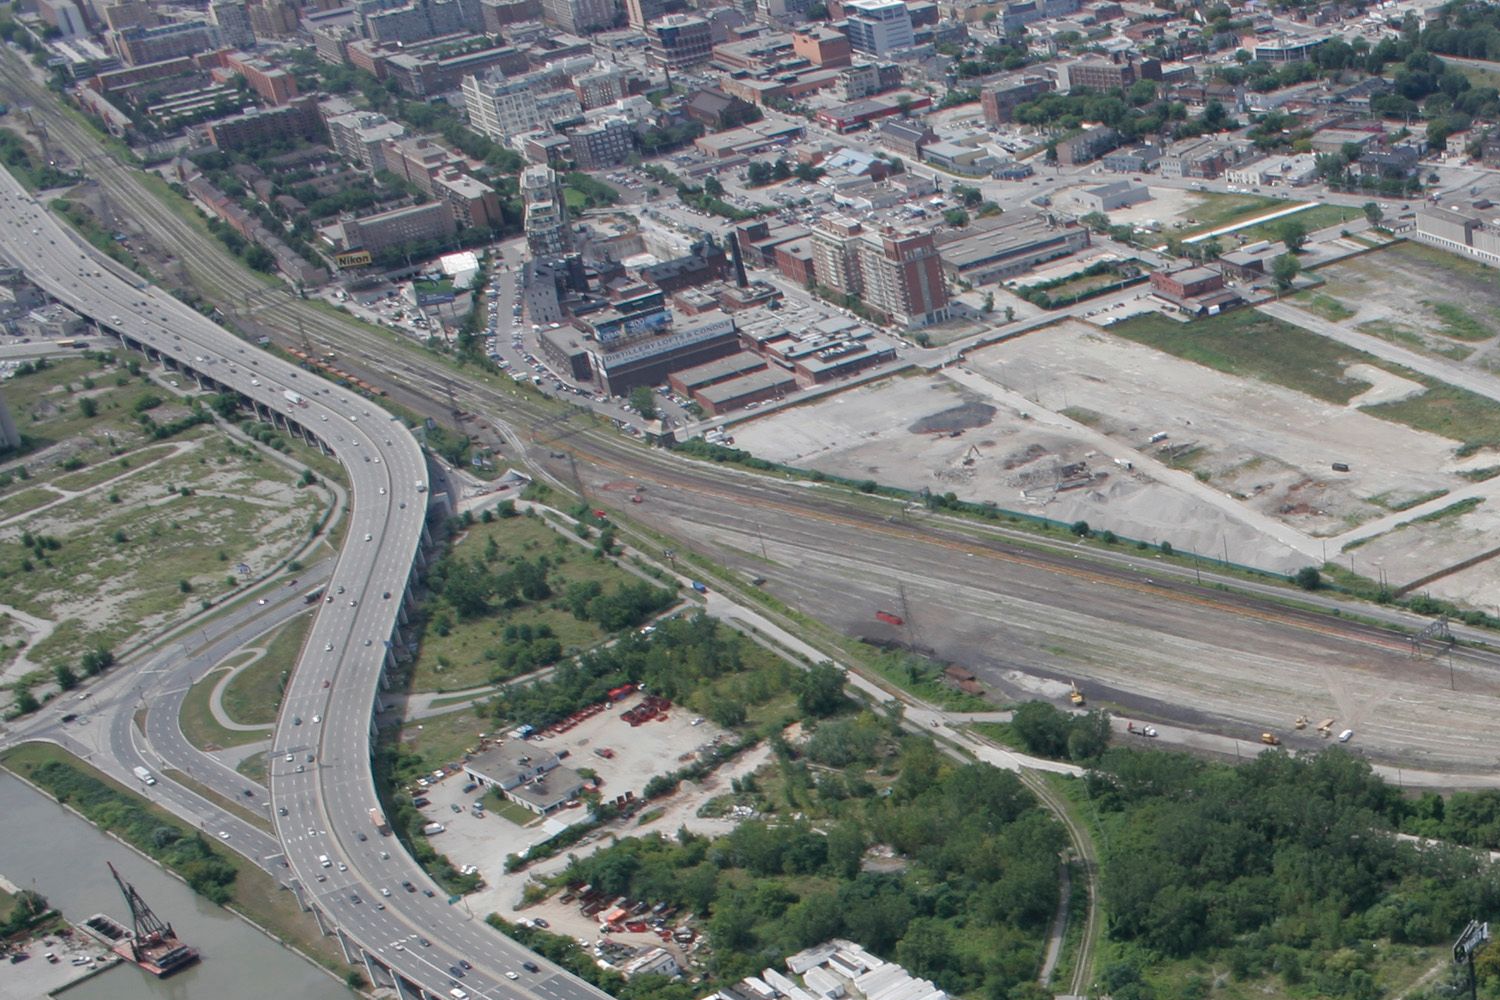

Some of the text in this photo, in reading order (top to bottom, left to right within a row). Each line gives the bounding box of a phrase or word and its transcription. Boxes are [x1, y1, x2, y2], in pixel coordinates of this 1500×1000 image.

[339, 255, 369, 266] Nikon
[606, 343, 655, 361] DISTILLERY
[656, 334, 686, 346] LOFTS
[694, 320, 730, 336] CONDOS
